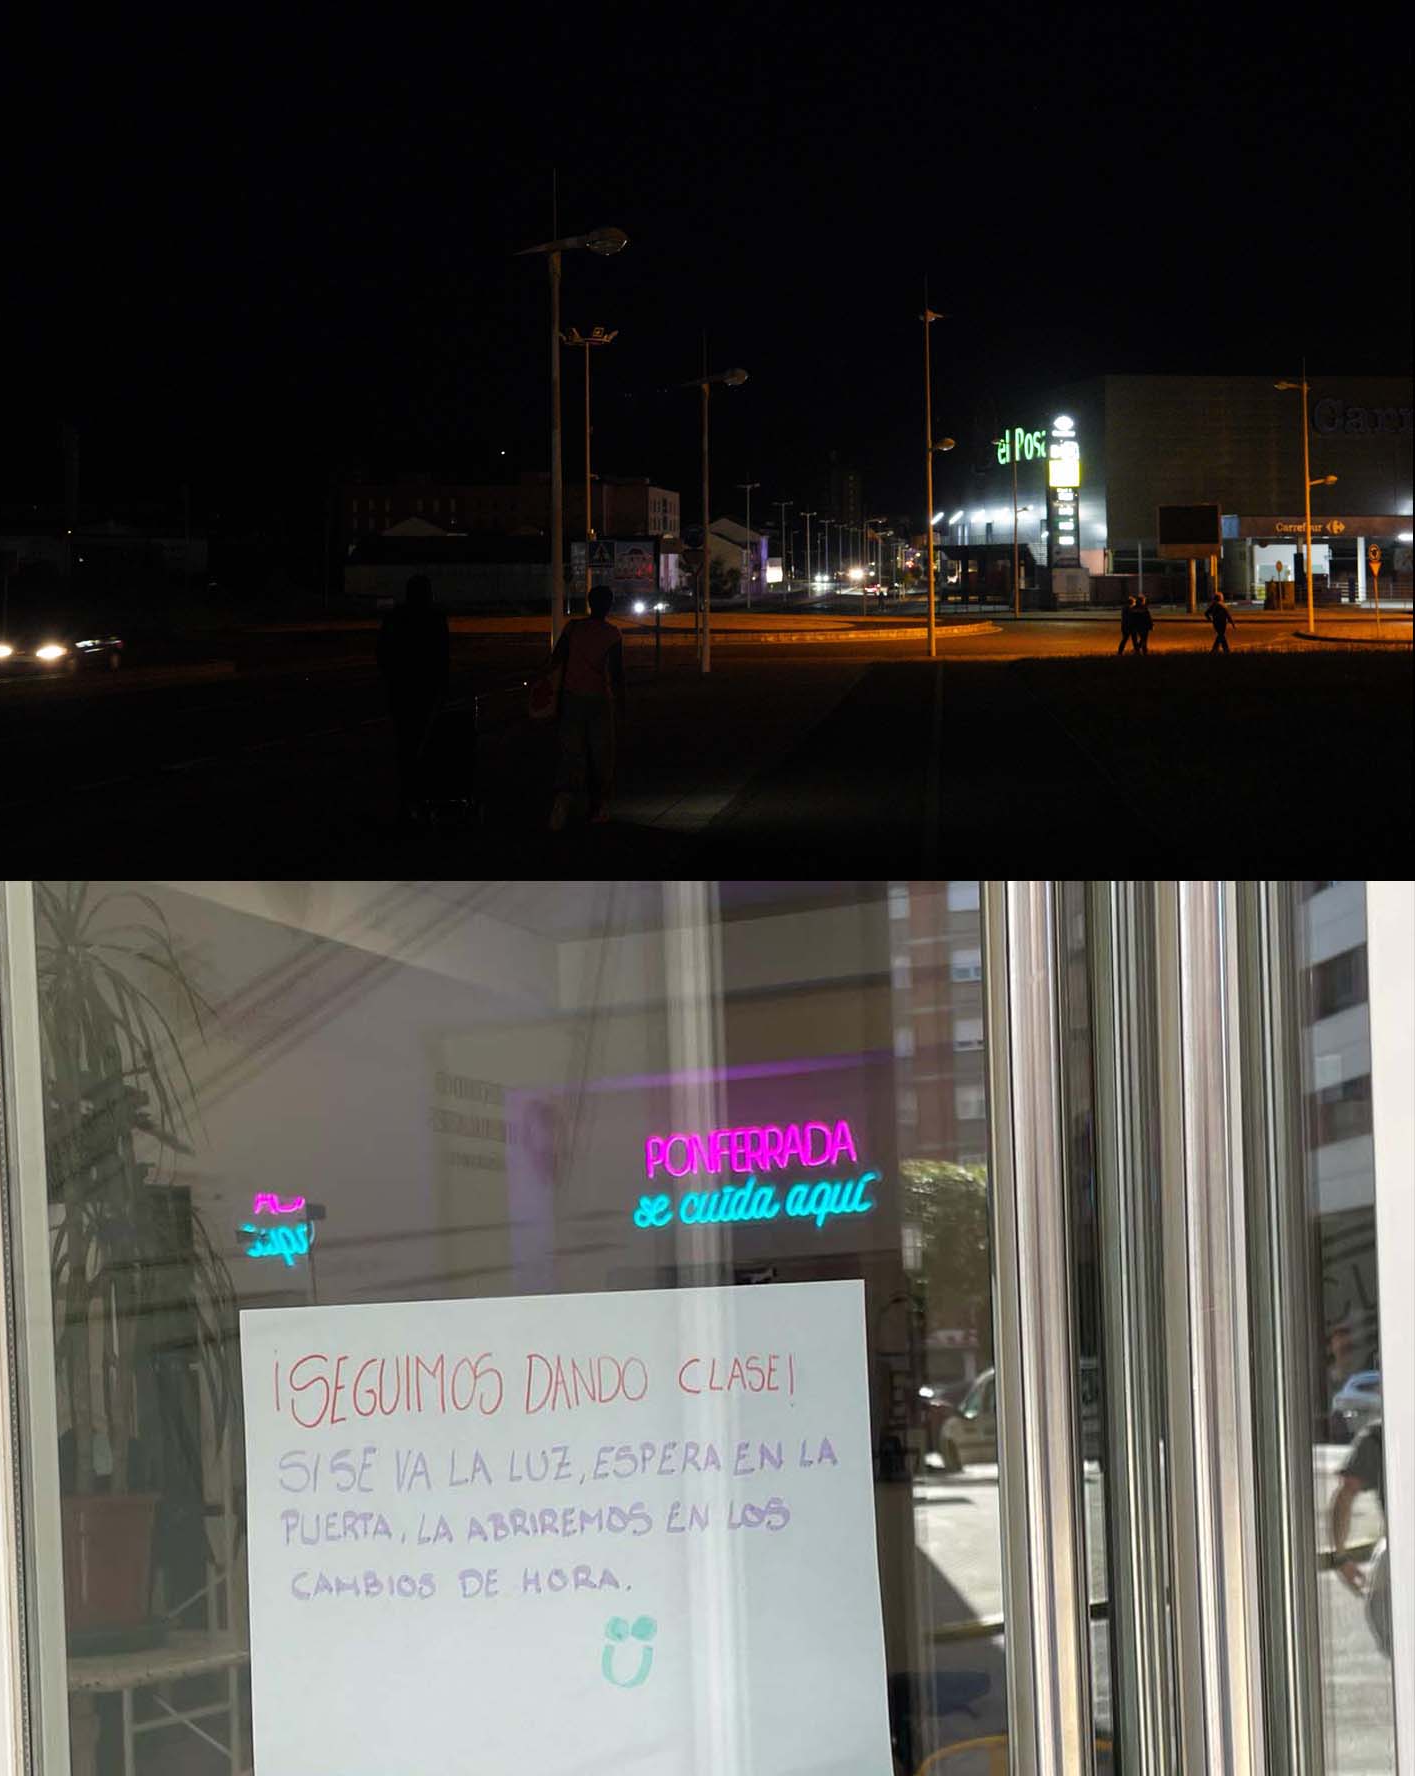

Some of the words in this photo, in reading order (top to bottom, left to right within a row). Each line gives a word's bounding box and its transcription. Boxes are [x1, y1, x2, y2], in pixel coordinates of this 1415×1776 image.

[1275, 521, 1323, 532] Carrefur
[645, 1119, 858, 1179] PONFERRADA
[634, 1194, 674, 1229] se
[680, 1174, 781, 1225] cuida
[786, 1171, 880, 1229] aquí
[525, 1353, 649, 1414] DANDO
[278, 1450, 321, 1494] SI
[329, 1446, 378, 1493] SE
[395, 1448, 432, 1492] VA
[449, 1448, 493, 1487] LA
[732, 1440, 785, 1477] EN
[798, 1435, 839, 1469] LA
[416, 1512, 454, 1545] LA
[466, 1501, 653, 1544] ABRIREMOS
[665, 1500, 710, 1534] EN
[727, 1496, 792, 1532] LOS
[290, 1569, 437, 1601] CAMBIOS
[457, 1567, 500, 1600] DE
